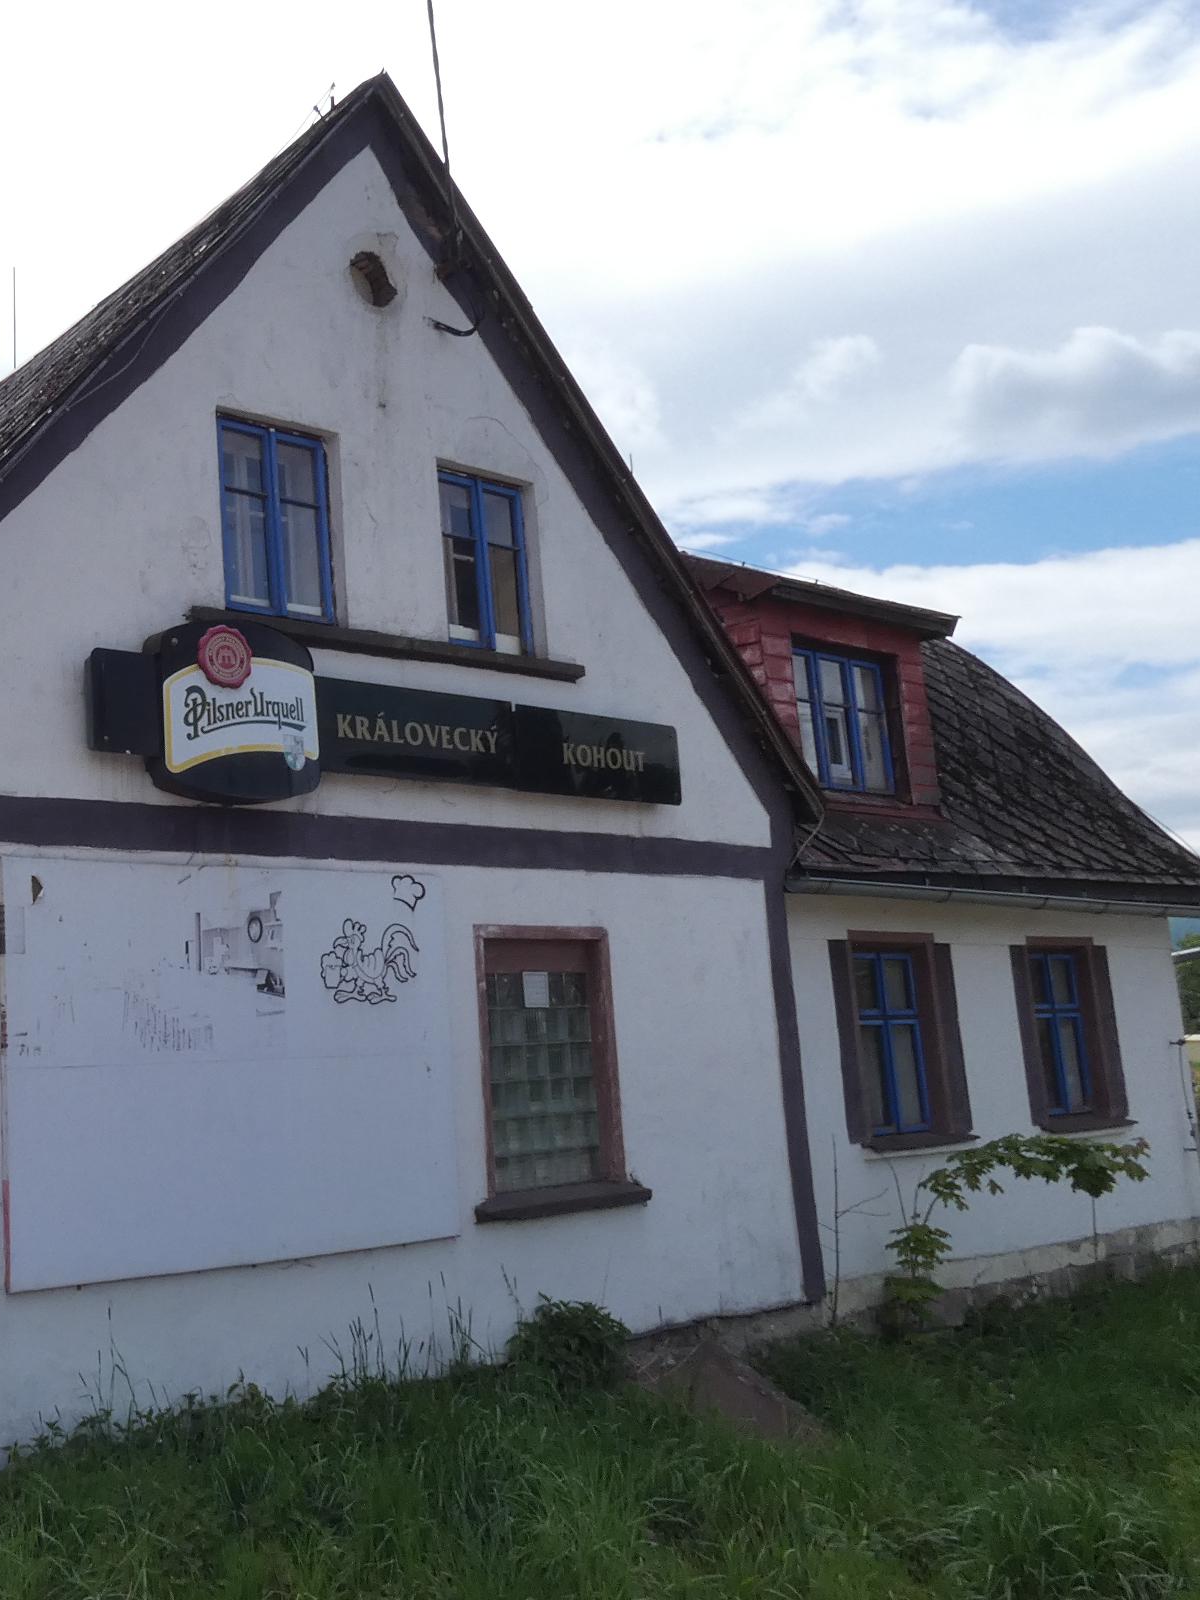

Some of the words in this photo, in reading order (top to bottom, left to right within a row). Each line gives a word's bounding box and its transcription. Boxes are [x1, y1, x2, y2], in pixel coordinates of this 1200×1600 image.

[183, 685, 251, 740] Pilsner
[250, 687, 305, 730] Urquell
[336, 711, 498, 755] KRÁLOVECKÝ
[563, 741, 646, 773] KOHOUT
